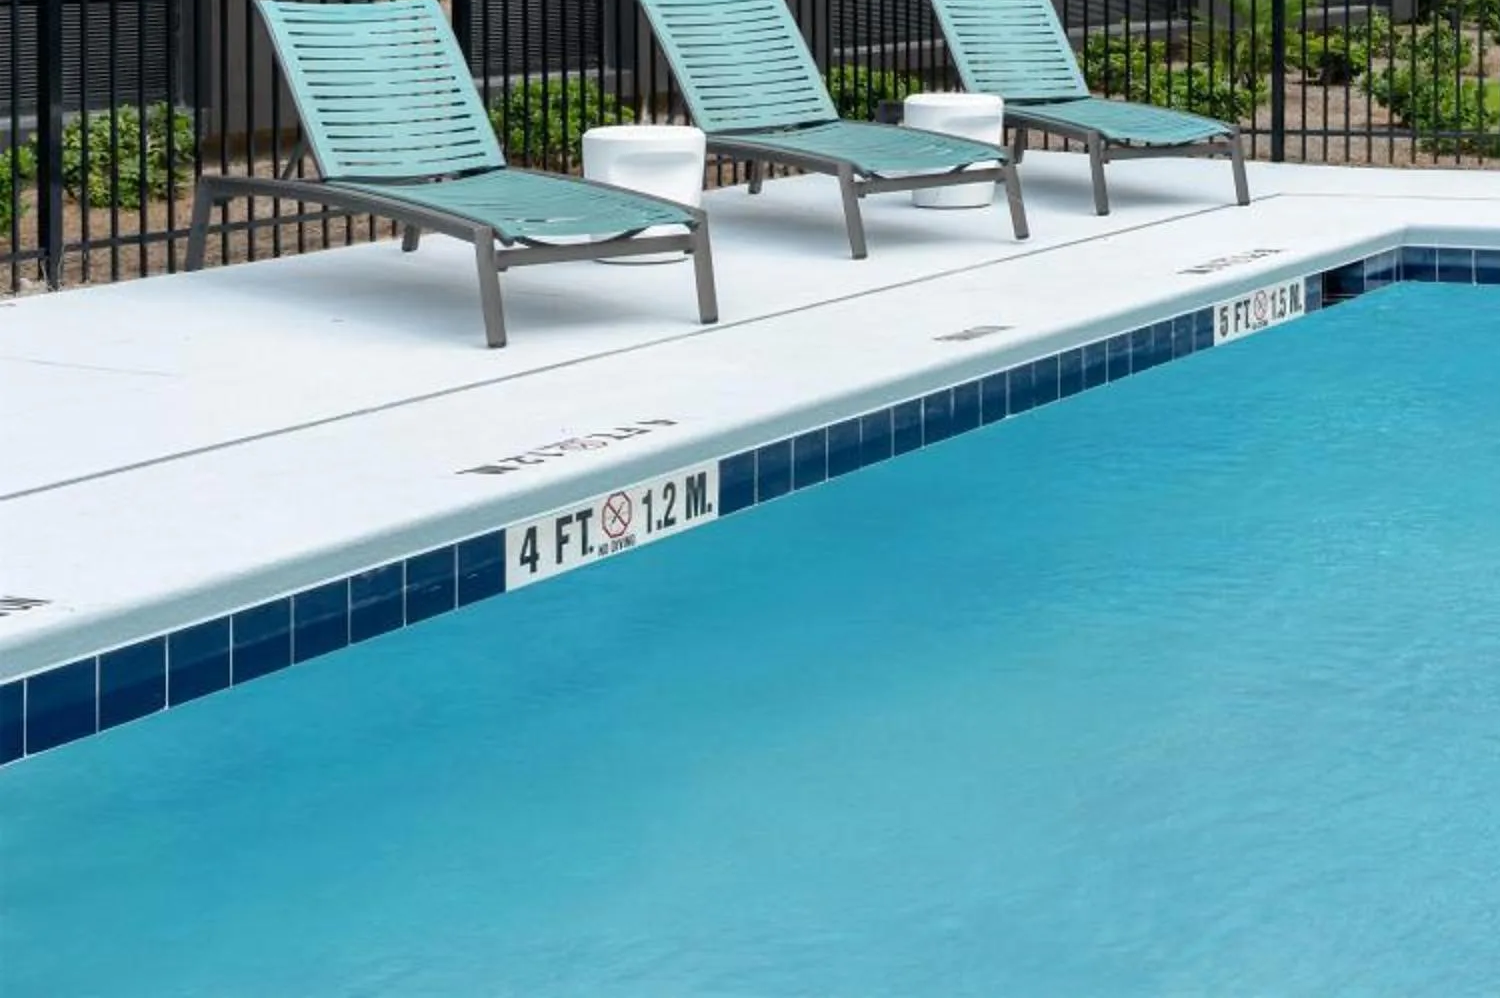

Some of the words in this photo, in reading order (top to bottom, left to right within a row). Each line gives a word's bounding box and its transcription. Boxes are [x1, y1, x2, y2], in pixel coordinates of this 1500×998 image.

[1219, 305, 1229, 337] 5
[519, 526, 540, 574] 4
[555, 508, 594, 565] FT.
[641, 481, 677, 534] 1.2
[685, 471, 713, 520] M.
